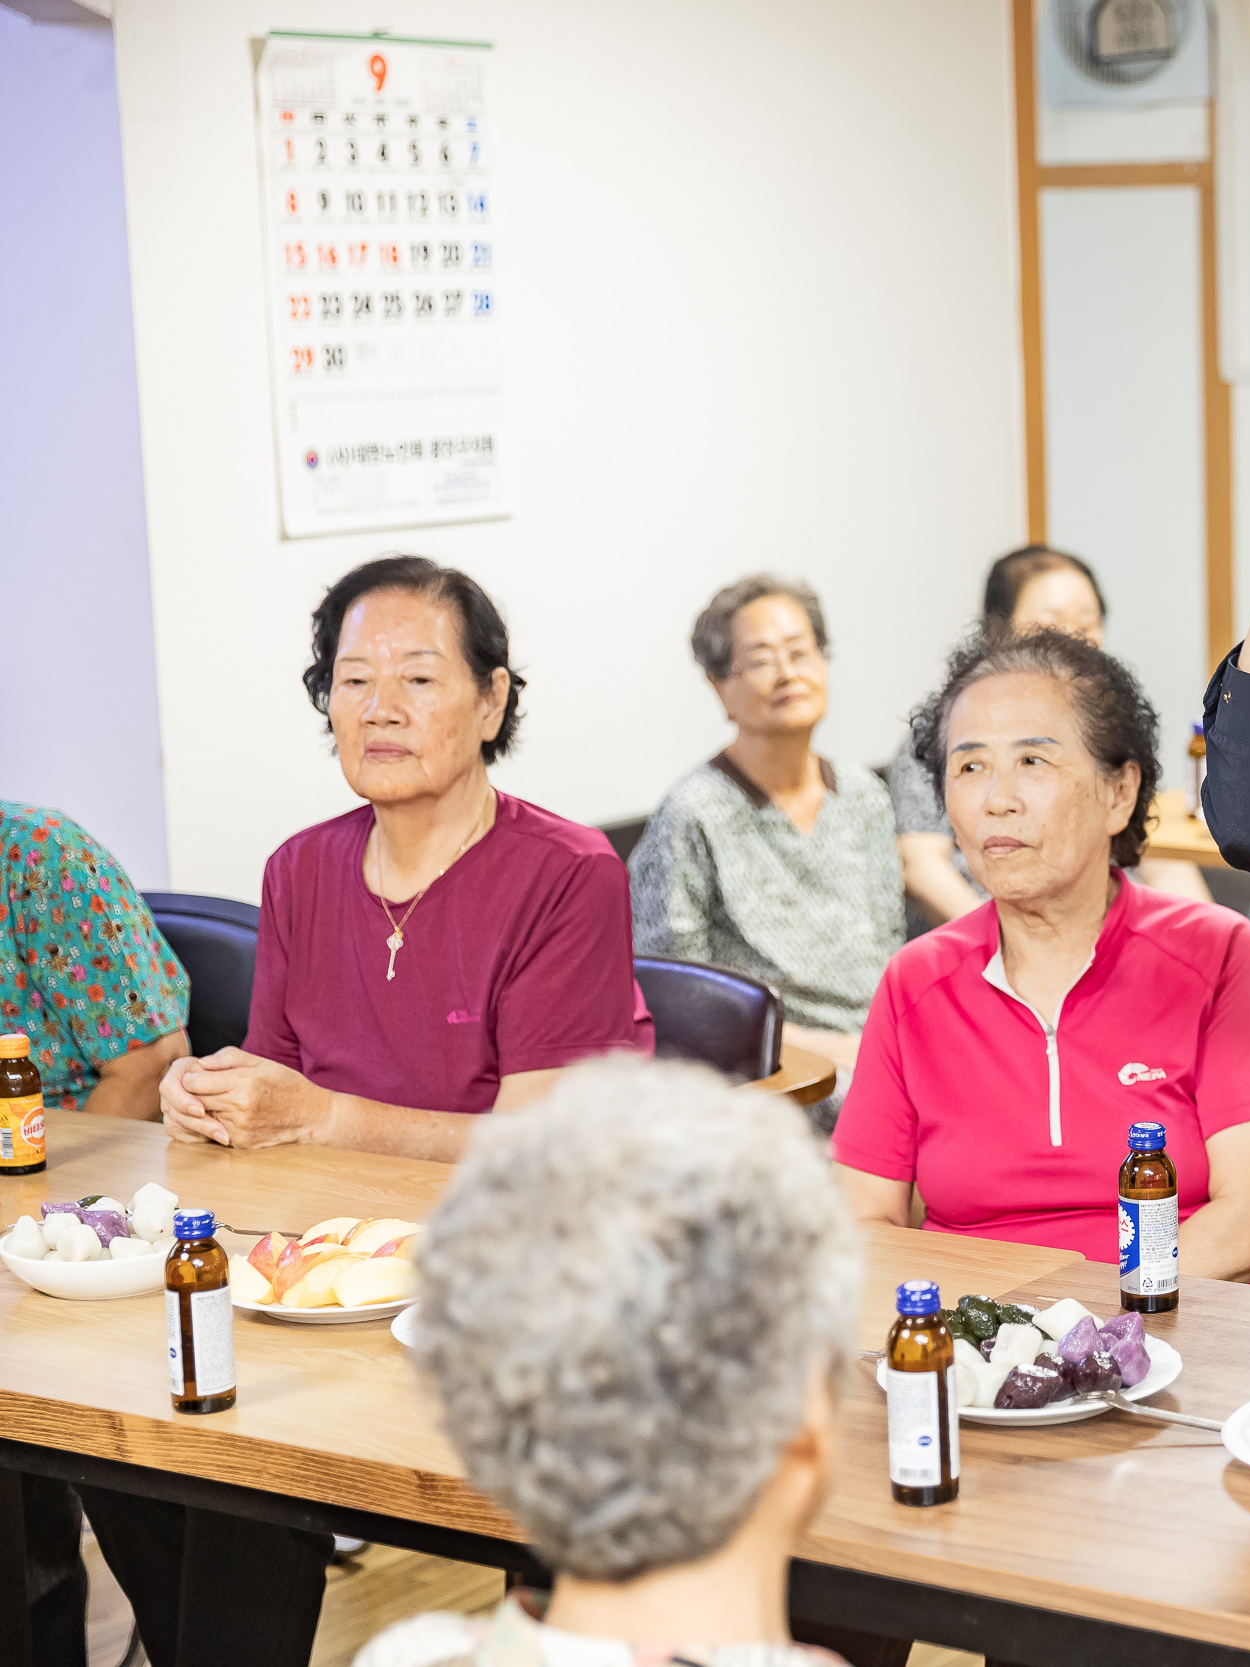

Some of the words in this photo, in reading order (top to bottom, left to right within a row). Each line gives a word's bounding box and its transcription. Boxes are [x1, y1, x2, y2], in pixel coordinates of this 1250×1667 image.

[369, 54, 387, 91] 9
[285, 138, 294, 163] 1
[317, 138, 327, 164] 2
[347, 139, 357, 166] 3
[377, 140, 388, 166] 4
[409, 140, 419, 167] 5
[440, 141, 450, 167] 6
[469, 140, 480, 169] 7
[287, 191, 297, 216] 8
[319, 191, 329, 216] 9
[346, 191, 364, 215] 10
[377, 191, 398, 215] 11
[407, 191, 429, 217] 12
[437, 191, 457, 216] 13
[467, 191, 486, 214] 14
[285, 241, 306, 268] 15
[316, 242, 337, 266] 16
[348, 241, 367, 266] 17
[379, 242, 398, 267] 18
[410, 242, 430, 266] 19
[440, 242, 462, 268] 20
[471, 242, 492, 268] 21
[289, 295, 311, 319] 22
[321, 293, 343, 319] 23
[352, 293, 372, 318] 24
[382, 291, 404, 319] 25
[413, 292, 435, 318] 26
[444, 290, 462, 317] 27
[472, 291, 493, 317] 28
[291, 347, 314, 374] 29
[324, 346, 345, 371] 30
